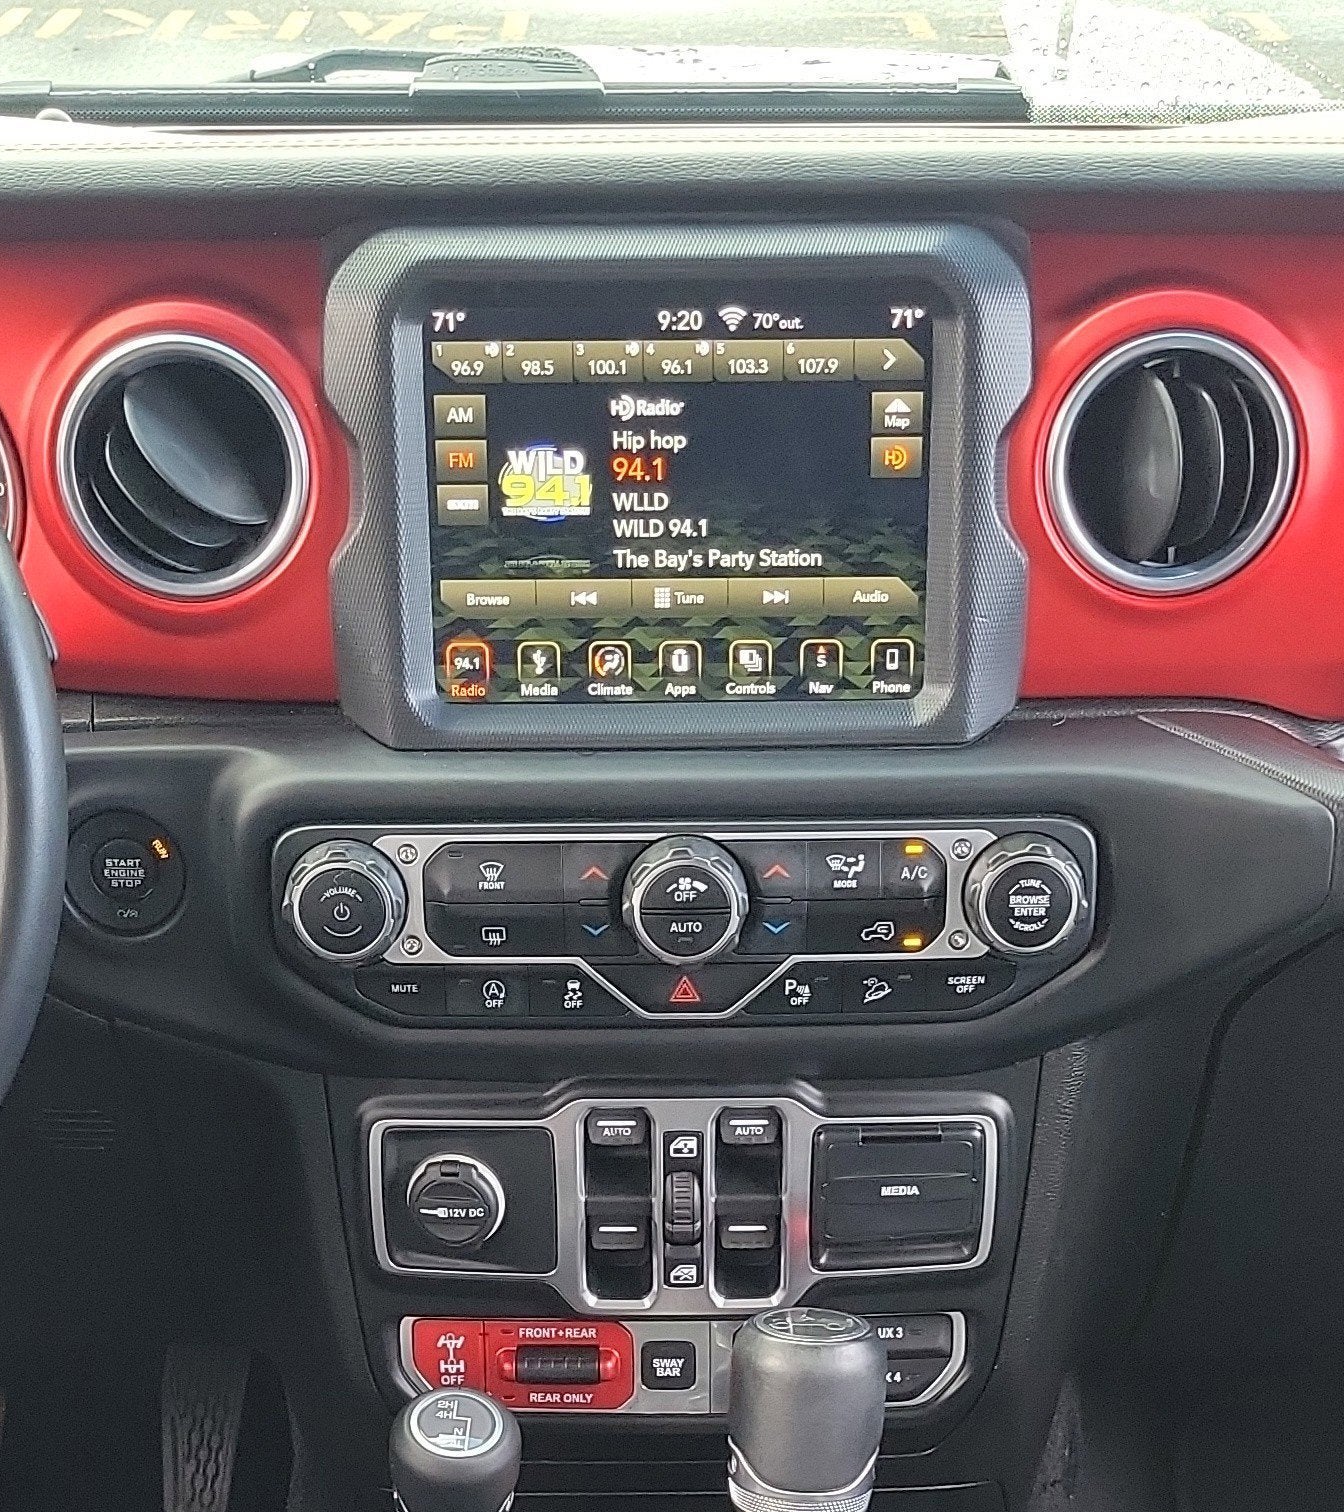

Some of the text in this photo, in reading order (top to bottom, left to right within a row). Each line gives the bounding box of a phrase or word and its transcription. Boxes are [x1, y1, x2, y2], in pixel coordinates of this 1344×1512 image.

[431, 311, 467, 333] 71°
[657, 310, 703, 332] 9:20
[889, 307, 925, 329] 71°
[436, 345, 443, 357] 1
[505, 345, 515, 357] 2
[576, 344, 585, 356] 3
[645, 344, 655, 356] 4
[716, 343, 725, 355] 5
[786, 342, 795, 355] 6
[450, 360, 484, 377] 96.9
[521, 360, 554, 376] 98.5
[588, 359, 627, 376] 100.1
[661, 359, 692, 375] 96.1
[728, 358, 769, 375] 103.3
[798, 358, 839, 375] 107.9
[446, 407, 474, 423] AM
[884, 414, 911, 430] Map
[612, 430, 687, 453] Hip hop
[449, 452, 474, 468] FM
[507, 449, 585, 482] WILD
[611, 456, 665, 482] 94.1
[612, 492, 669, 512] WLLD
[612, 518, 708, 538] WILD 94.1
[612, 549, 648, 569] The
[654, 548, 704, 572] Bay's
[708, 549, 755, 572] Party
[759, 549, 823, 568] Station
[466, 592, 511, 607] Browse
[674, 591, 705, 605] Tune
[852, 590, 889, 604] Audio
[453, 655, 480, 671] 94.1
[816, 654, 827, 668] S
[451, 684, 487, 698] Radio
[520, 683, 559, 698] Media
[587, 682, 634, 696] Climate
[664, 682, 697, 698] Apps
[725, 682, 777, 695] Controls
[808, 681, 834, 695] Nav
[872, 680, 911, 694] Phone
[105, 858, 142, 868] START
[103, 868, 146, 878] ENGINE
[900, 865, 928, 881] A/C
[110, 879, 143, 888] STOP
[478, 881, 505, 891] FRONT
[833, 879, 858, 889] MODE
[1018, 878, 1043, 889] TUNE
[324, 886, 358, 898] VOLUME
[674, 891, 697, 903] OFF
[1009, 894, 1051, 905] BROWSE
[1013, 907, 1047, 917] ENTER
[669, 921, 703, 934] AUTO
[1013, 920, 1046, 932] SCROLL
[947, 975, 986, 986] SCREEN
[390, 983, 419, 994] MUTE
[784, 979, 796, 996] P
[955, 985, 976, 995] OFF
[484, 998, 504, 1009] OFF
[563, 998, 583, 1010] OFF
[789, 996, 810, 1007] OFF
[602, 1126, 631, 1137] AUTO
[734, 1126, 764, 1136] AUTO
[880, 1185, 920, 1196] MEDIA
[447, 1206, 485, 1218] 12V DC
[895, 1326, 904, 1339] 3
[652, 1358, 685, 1369] SWAY
[656, 1367, 681, 1378] BAR
[440, 1374, 465, 1386] OFF
[529, 1392, 594, 1404] REAR ONLY
[437, 1400, 454, 1410] 2H
[435, 1410, 453, 1420] 4H
[453, 1427, 464, 1436] N
